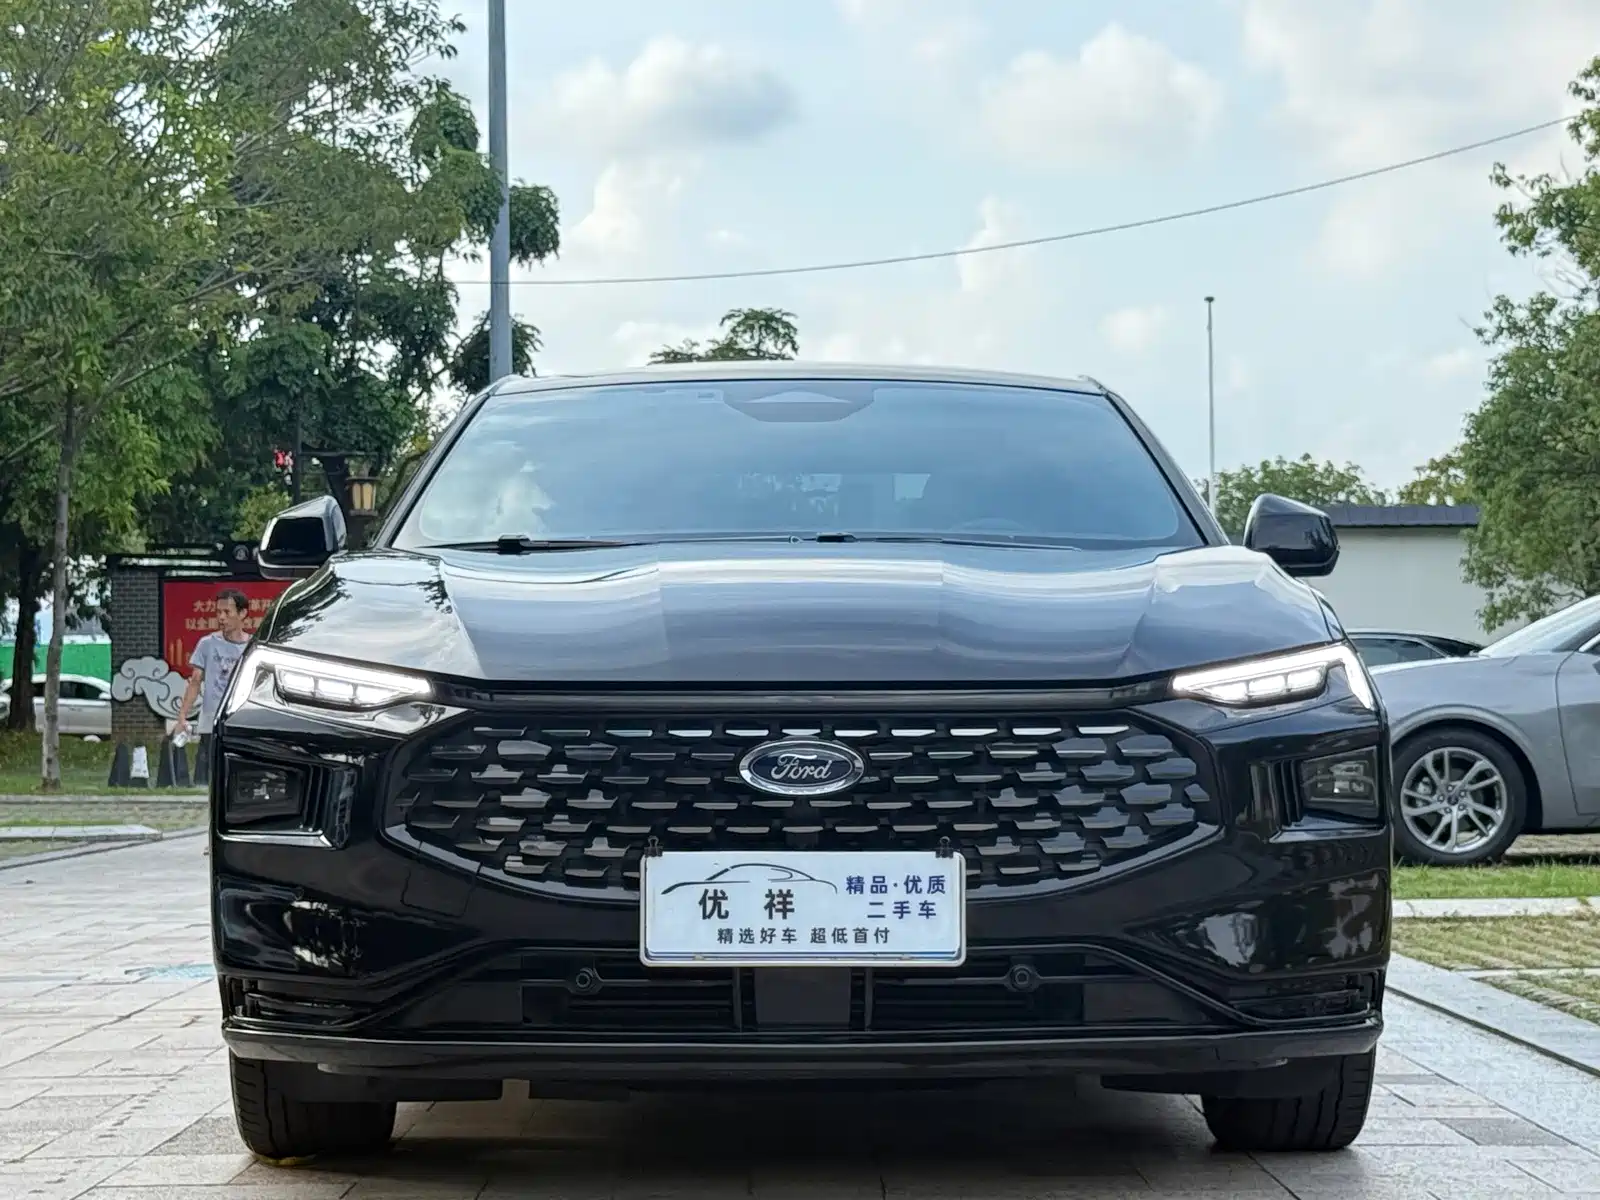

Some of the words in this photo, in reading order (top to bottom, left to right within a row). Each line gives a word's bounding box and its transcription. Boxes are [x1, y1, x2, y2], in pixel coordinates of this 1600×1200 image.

[771, 753, 832, 780] Ford
[867, 900, 936, 920] 二手车
[717, 928, 797, 944] 精选好车
[810, 927, 890, 944] 超低首付
